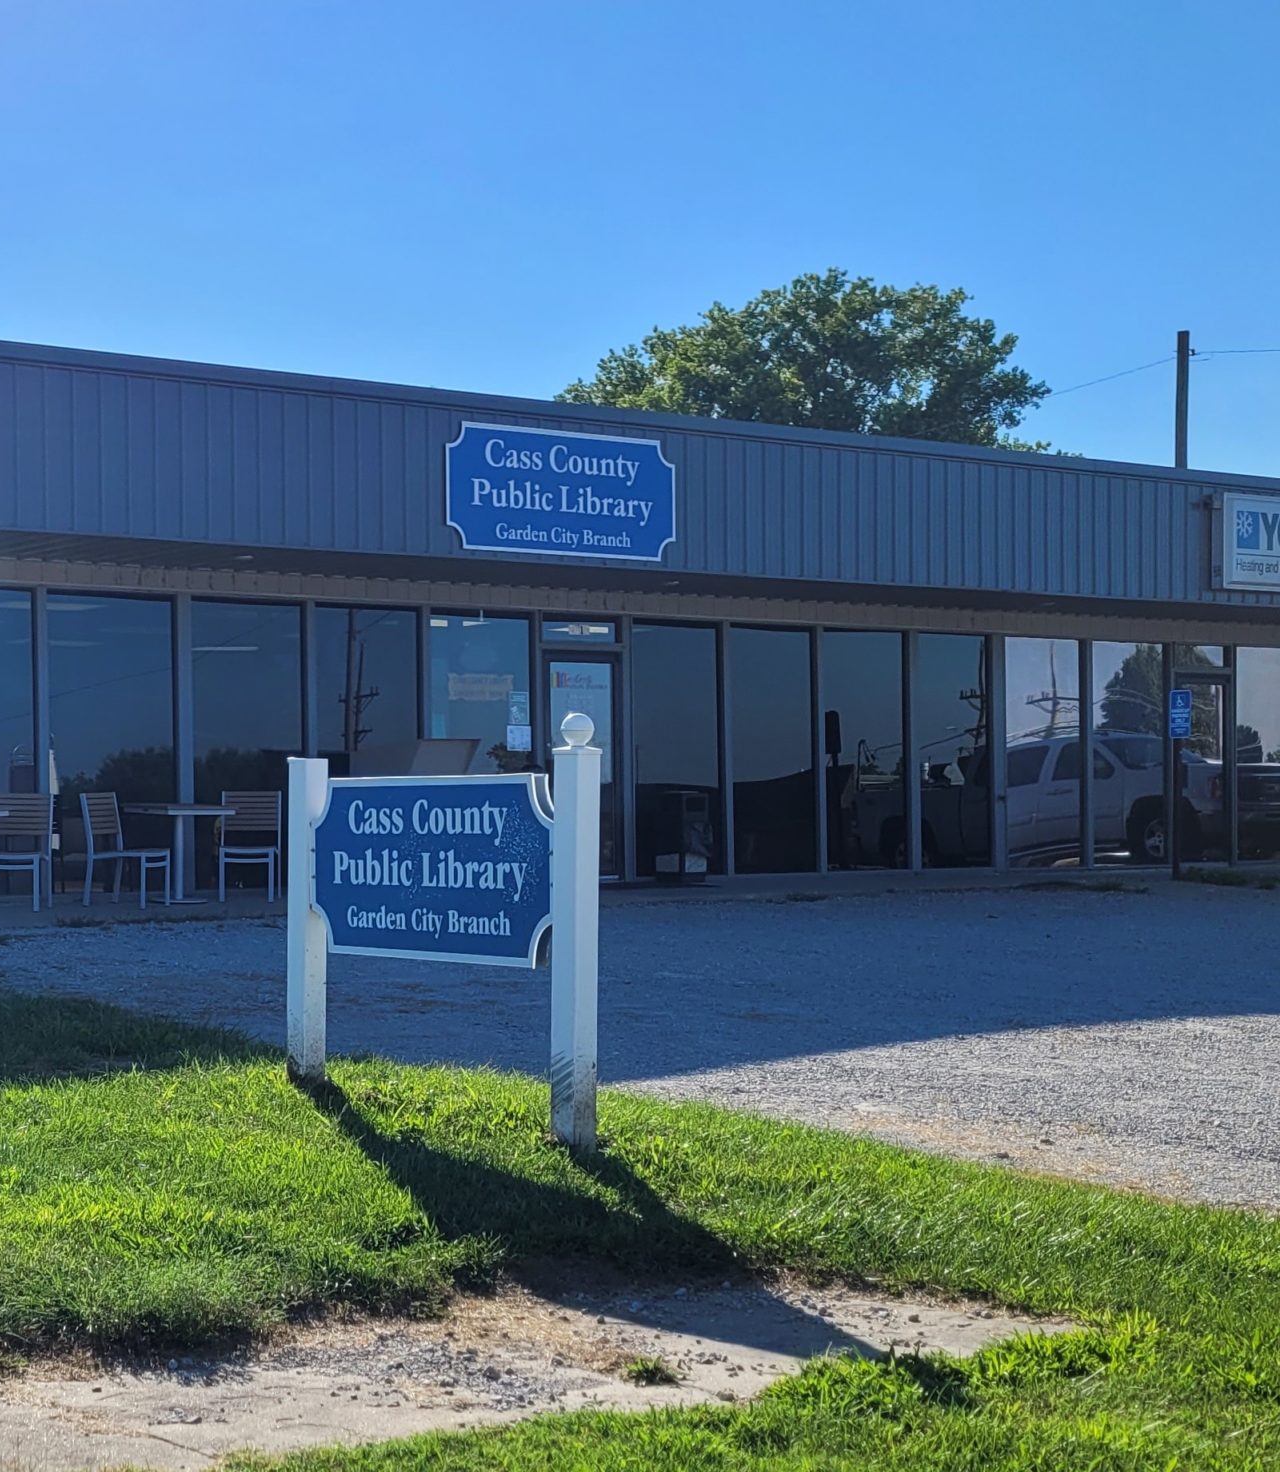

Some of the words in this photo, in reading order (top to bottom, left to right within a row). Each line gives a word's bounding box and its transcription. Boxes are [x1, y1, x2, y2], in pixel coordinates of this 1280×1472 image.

[485, 439, 542, 471] Cass
[549, 445, 640, 486] County
[471, 478, 553, 511] Public
[559, 485, 653, 527] Library
[495, 523, 548, 543] Garden
[551, 527, 579, 548] City
[583, 529, 631, 548] Branch
[1260, 512, 1280, 551] Y
[1265, 560, 1279, 573] and
[348, 799, 403, 834] Cass
[412, 799, 508, 846] County
[333, 848, 413, 887] Public
[421, 849, 527, 901] Library
[347, 905, 406, 931] Garden
[411, 908, 443, 939] City
[448, 910, 511, 936] Branch
